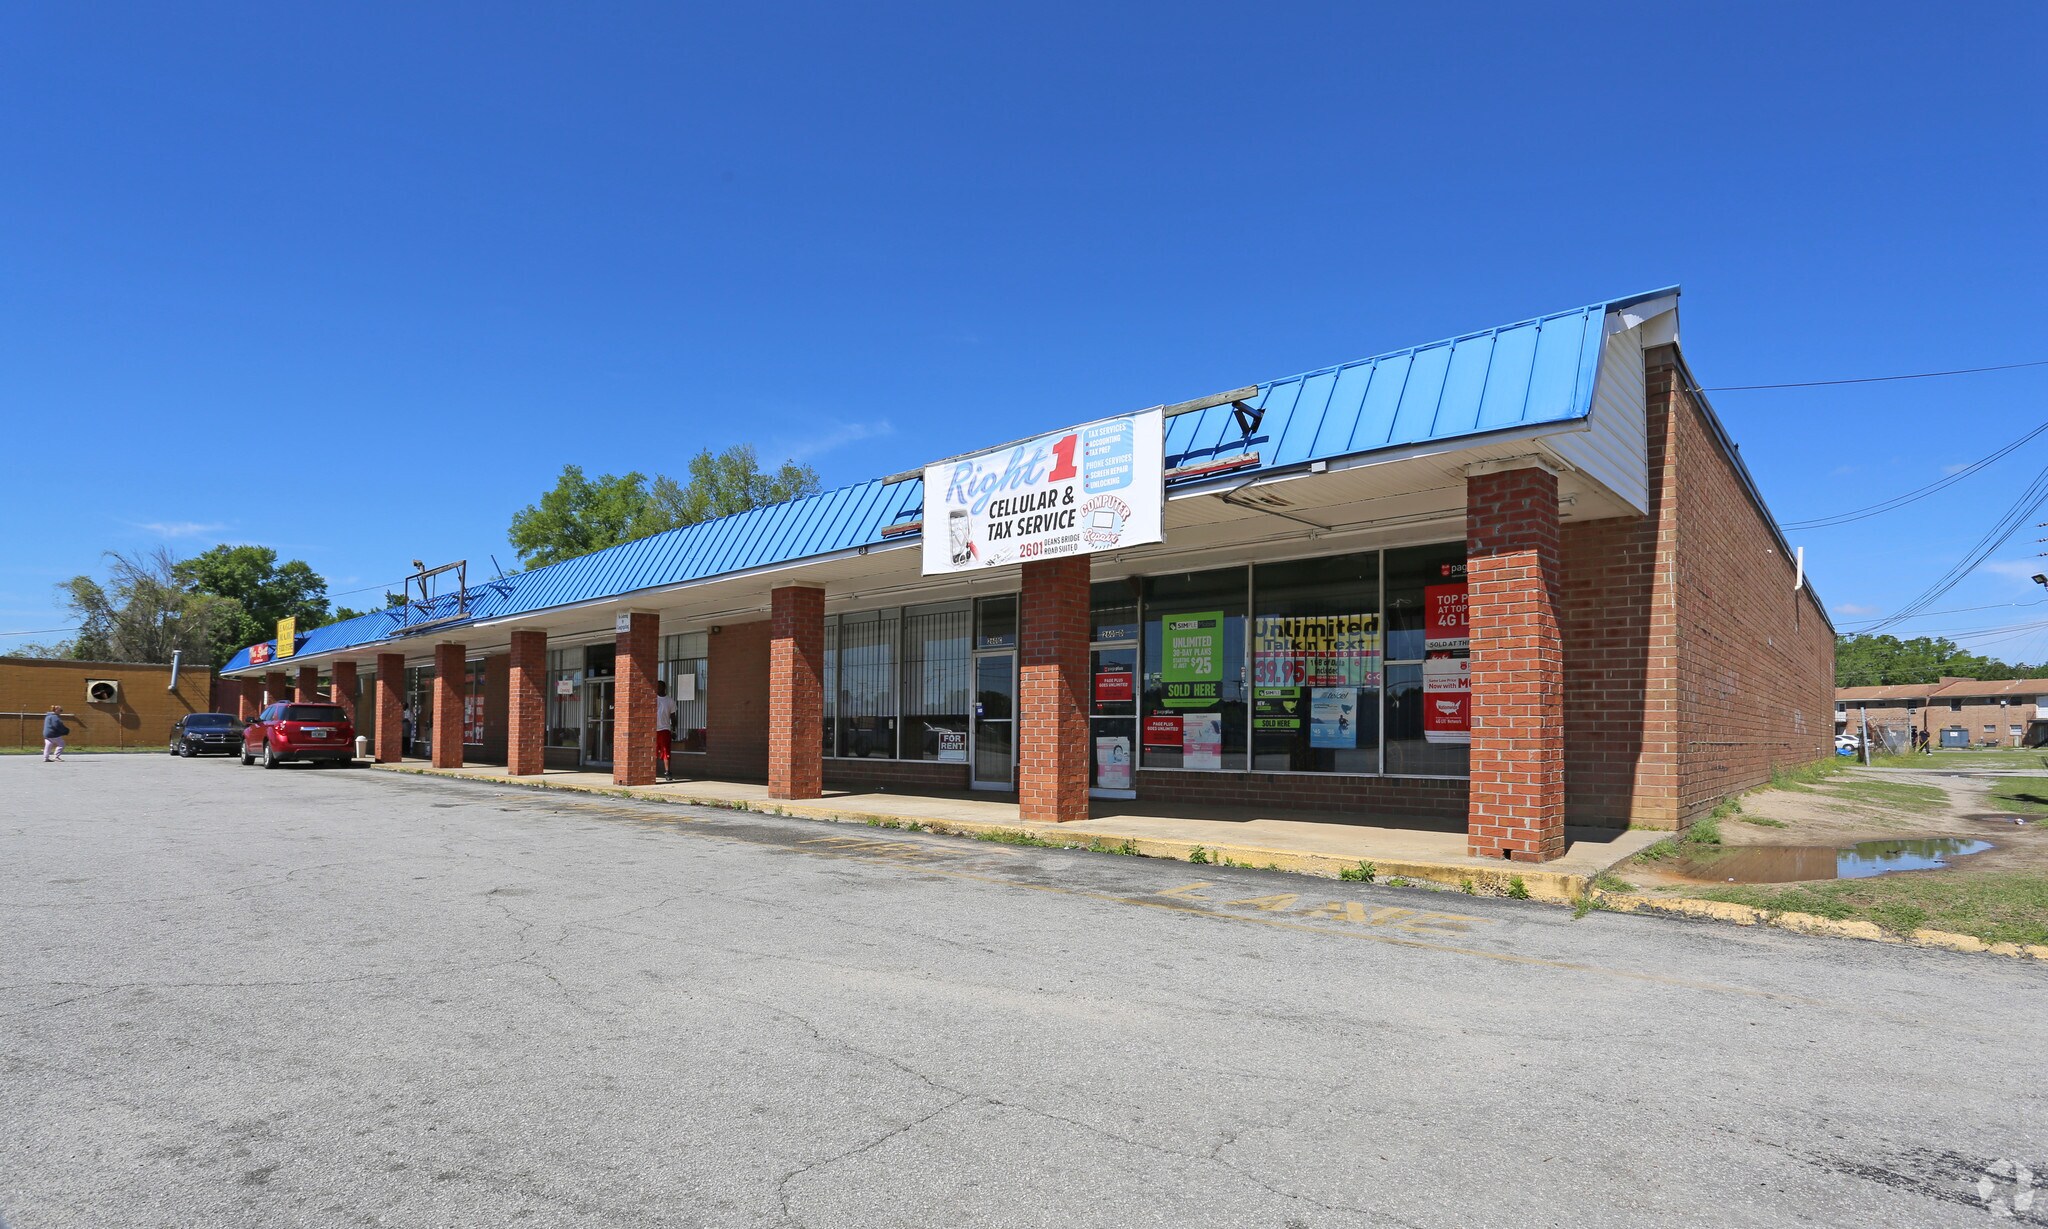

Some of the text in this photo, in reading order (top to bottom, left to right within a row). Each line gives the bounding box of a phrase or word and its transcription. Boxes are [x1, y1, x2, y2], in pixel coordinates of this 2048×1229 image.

[1088, 423, 1127, 438] TAX SERVICES
[945, 433, 1078, 516] Right 1
[989, 486, 1074, 519] CELLULAR &
[1080, 494, 1131, 521] COMPUTER
[987, 509, 1077, 541] TAX SERVICE
[1083, 528, 1119, 545] Repair
[1019, 541, 1043, 558] 2601
[1061, 533, 1080, 544] BRIDGE
[1437, 594, 1458, 604] TOP
[1438, 605, 1468, 614] AT TOP
[1255, 617, 1379, 637] Unlimited
[1438, 614, 1456, 626] 4G
[1172, 636, 1212, 648] UNLIMITED
[1264, 639, 1302, 650] Talk
[1323, 639, 1365, 650] Text
[1172, 647, 1212, 657] 30-DAY PLANS
[1190, 657, 1212, 674] $25
[1255, 660, 1305, 682] 39.95
[1168, 683, 1216, 697] SOLD HERE
